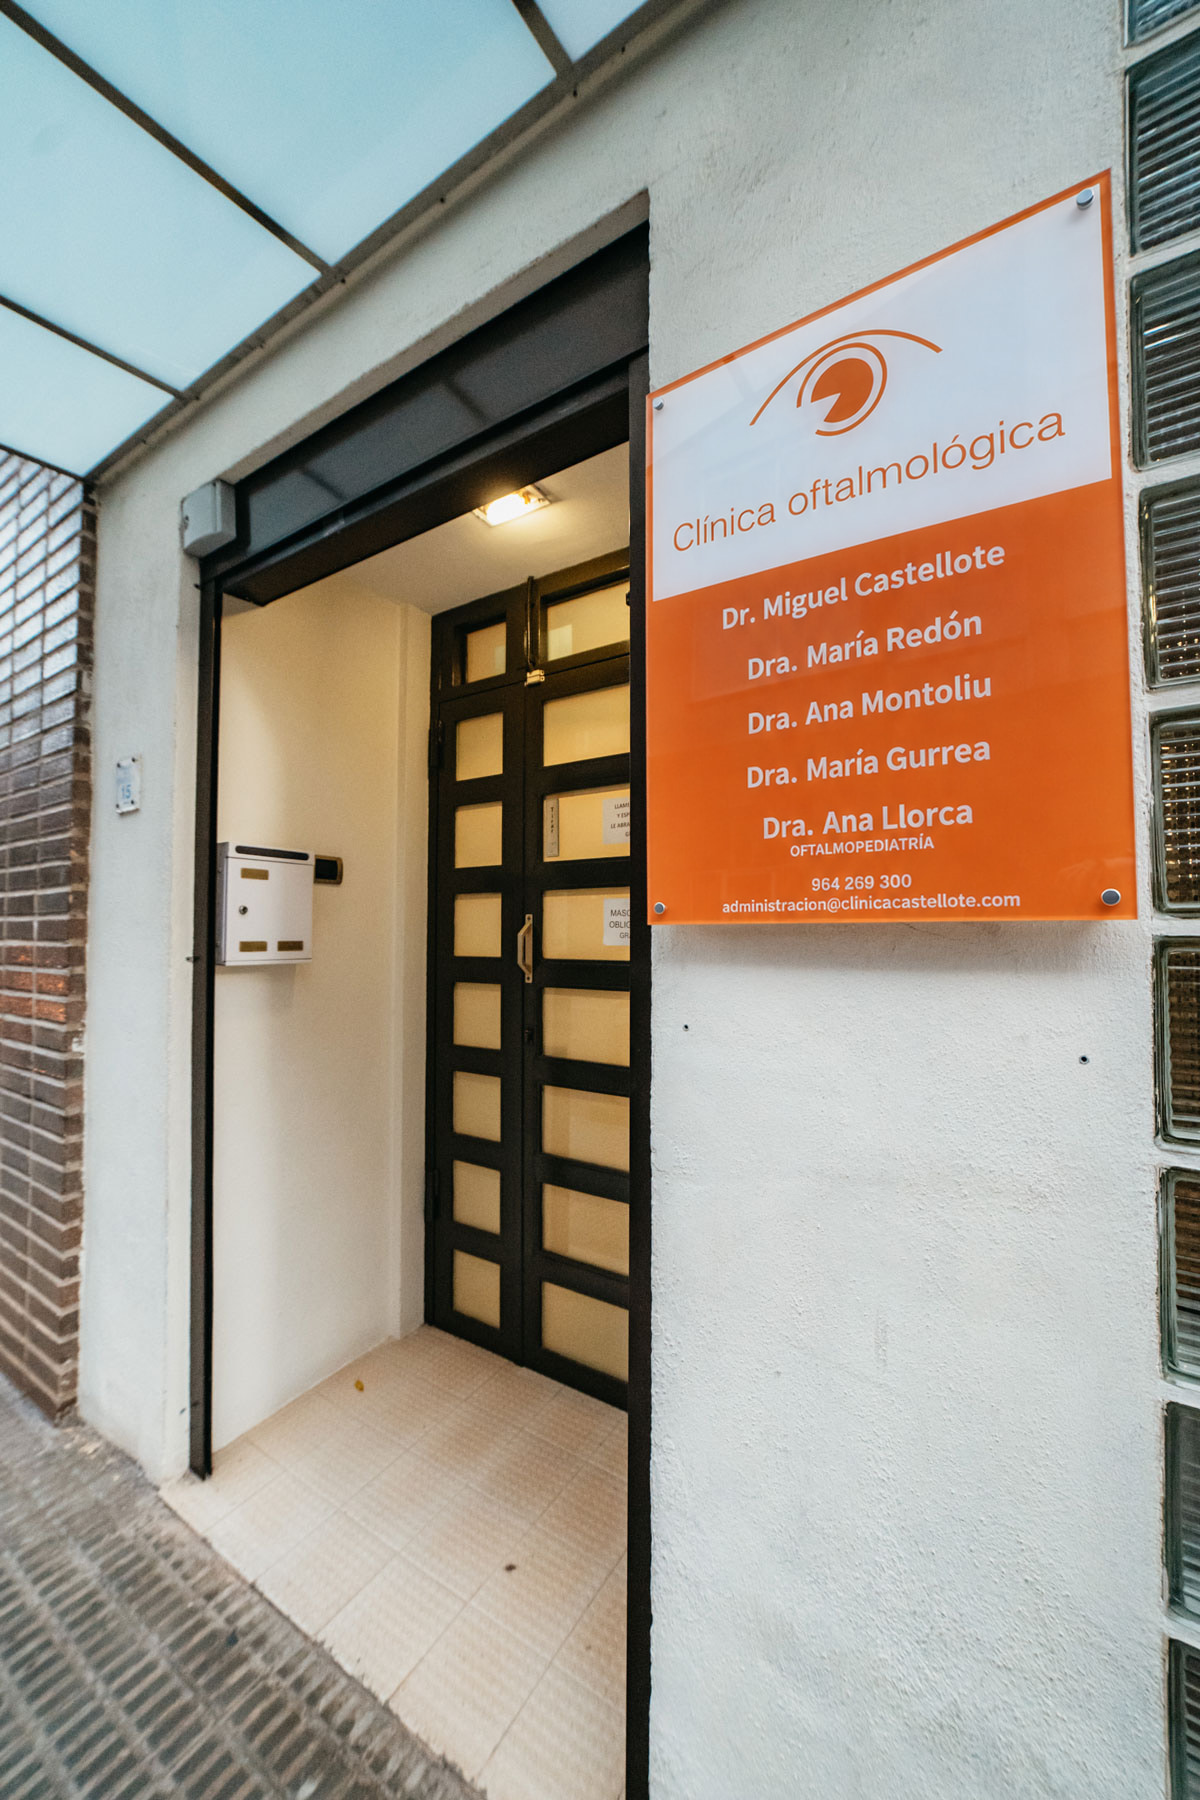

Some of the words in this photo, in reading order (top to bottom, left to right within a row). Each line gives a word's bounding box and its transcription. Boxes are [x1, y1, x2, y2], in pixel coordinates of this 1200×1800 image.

[674, 503, 776, 551] Clínica
[788, 412, 1066, 517] oftalmológica
[723, 608, 755, 629] Dr.
[764, 577, 848, 619] Miguel
[855, 546, 1005, 596] Castellote
[749, 656, 797, 680] Dra.
[808, 630, 878, 668] María
[887, 610, 981, 651] Redón
[749, 712, 797, 734] Dra.
[805, 701, 853, 725] Ana
[862, 674, 991, 715] Montoliu
[748, 767, 797, 788] Dra.
[808, 749, 878, 781] María
[887, 742, 990, 770] Gurrea
[121, 784, 131, 800] 15
[764, 817, 813, 839] Dra.
[823, 811, 873, 834] Ana
[883, 804, 973, 829] Llorca
[790, 833, 934, 857] OFTALMOPEDIATRÍA
[812, 877, 840, 891] 964
[845, 876, 874, 890] 269
[880, 874, 911, 888] 300
[723, 893, 1020, 913] administracion@clinicacastellote.com
